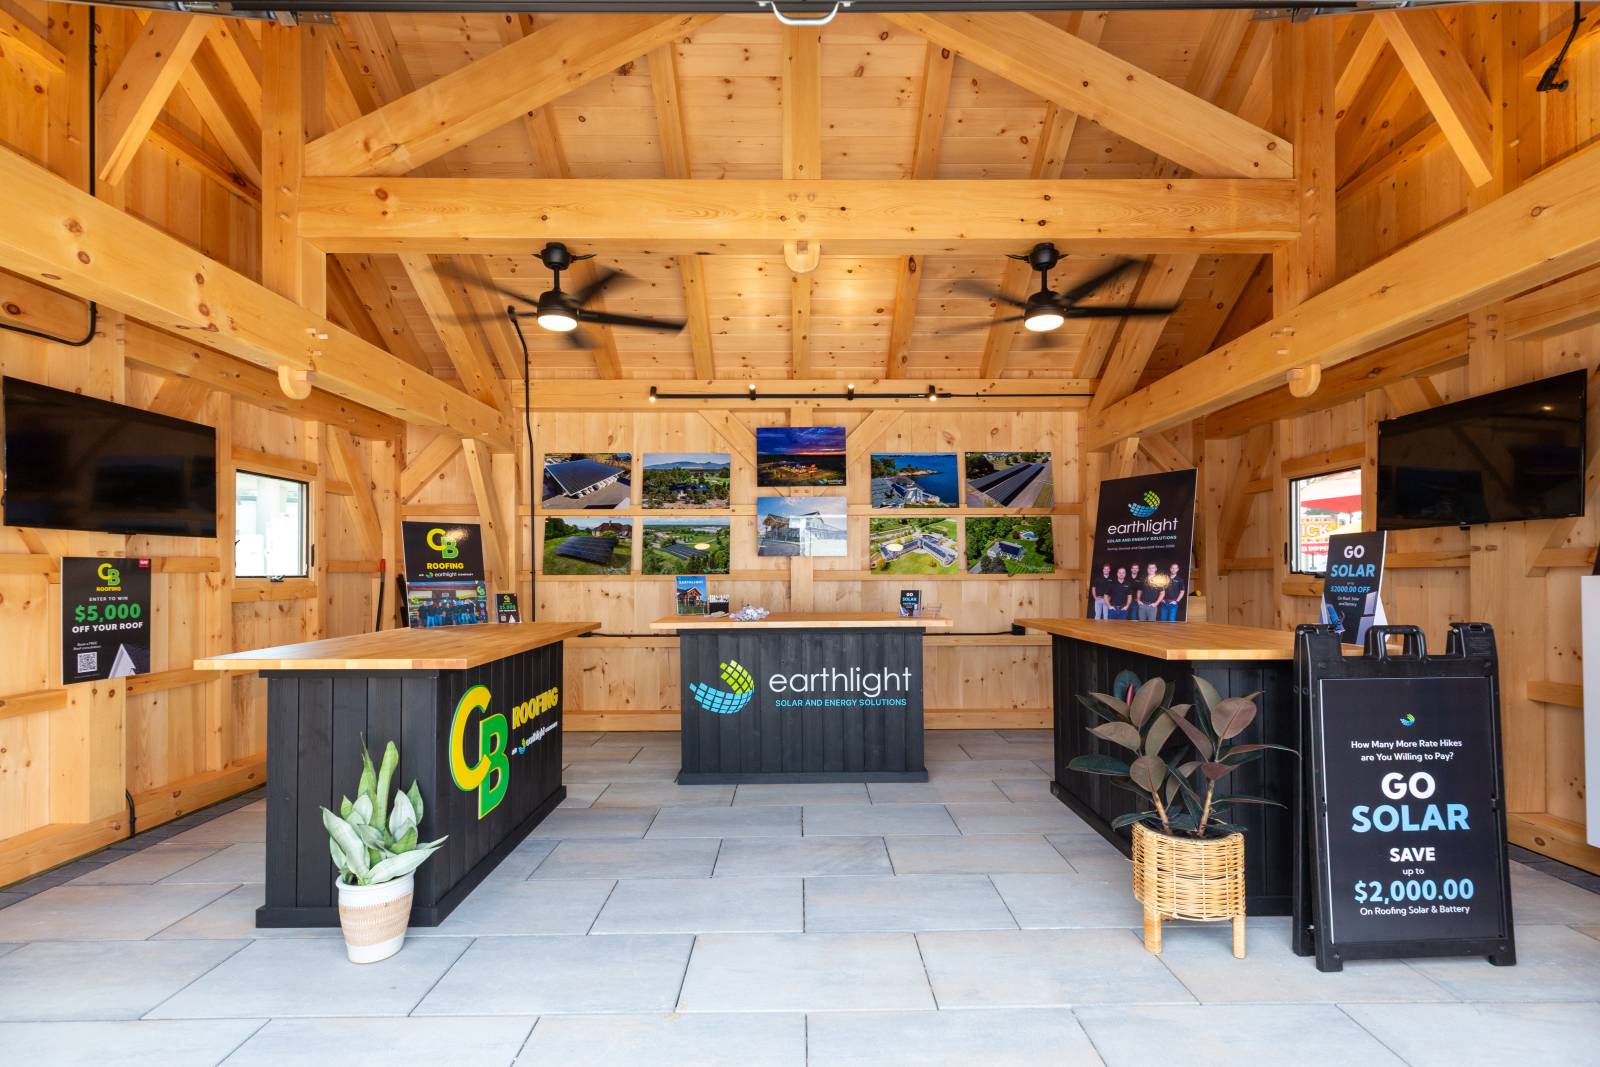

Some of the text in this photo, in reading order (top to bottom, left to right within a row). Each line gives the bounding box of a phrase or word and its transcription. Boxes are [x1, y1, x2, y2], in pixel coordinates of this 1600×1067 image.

[1108, 518, 1178, 534] earthlight
[1344, 545, 1365, 558] GO
[1330, 564, 1375, 577] SOLAR
[75, 603, 141, 622] $5,000
[769, 667, 912, 697] earthlight
[512, 687, 558, 730] ROOFING
[449, 684, 509, 820] CB
[1371, 740, 1394, 750] Many
[1394, 752, 1422, 762] Willing
[1435, 752, 1454, 761] Pay?
[1381, 772, 1436, 800] GO
[1351, 803, 1471, 833] SOLAR
[1390, 847, 1436, 862] SAVE
[1354, 878, 1474, 904] $2,000.00
[1375, 906, 1407, 916] Roofing
[1409, 906, 1429, 914] Solar
[1440, 905, 1470, 914] Battery
